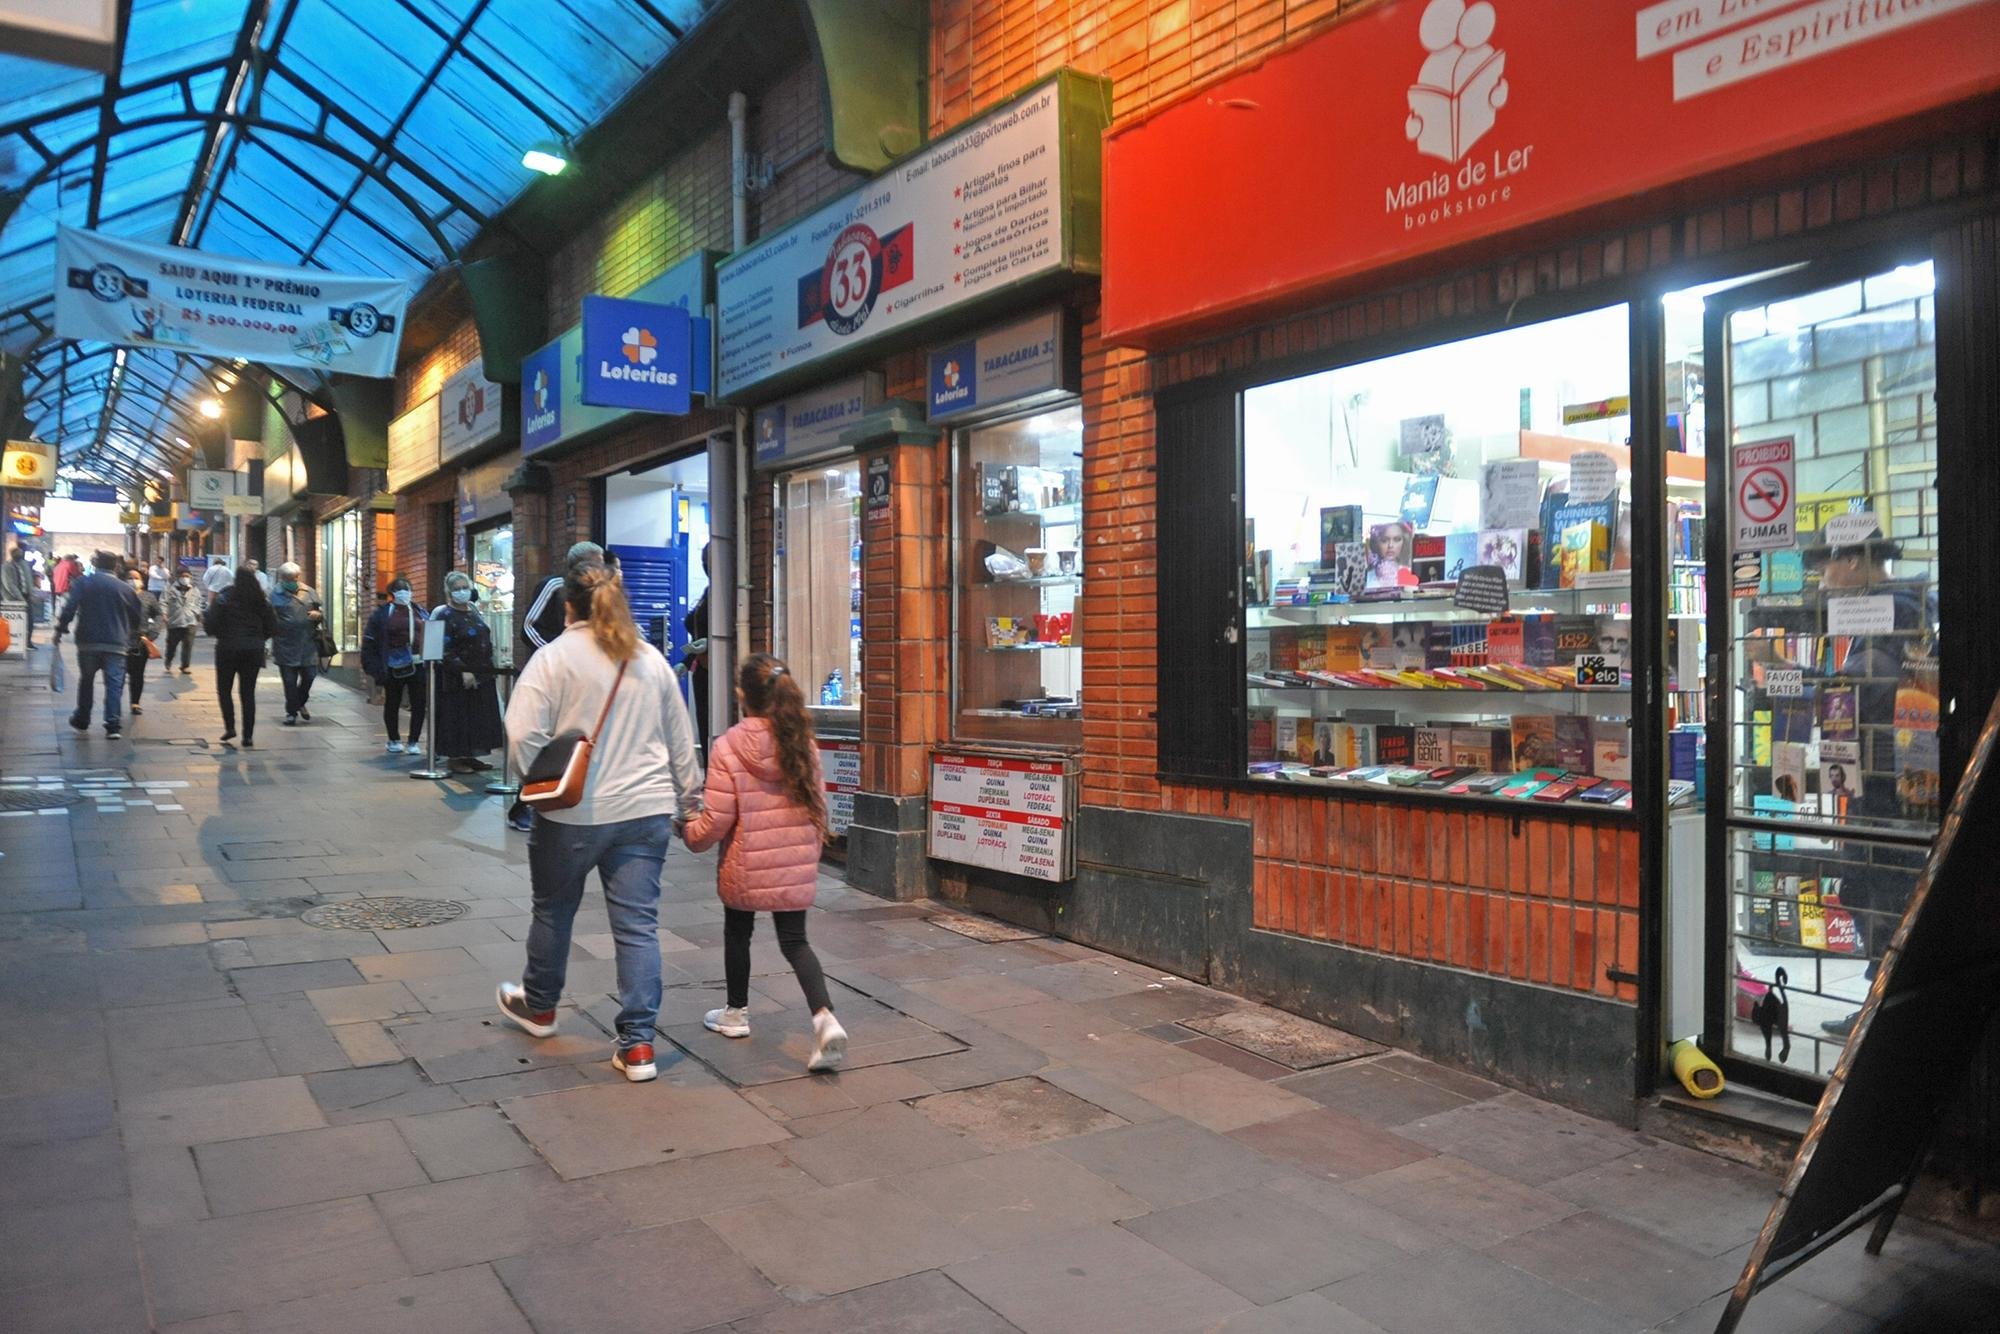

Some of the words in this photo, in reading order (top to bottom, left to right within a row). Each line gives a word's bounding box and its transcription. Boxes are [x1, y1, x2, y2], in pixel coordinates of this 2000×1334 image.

[1656, 7, 1700, 37] em
[1706, 54, 1722, 76] e
[963, 170, 995, 191] Artigos
[1023, 144, 1046, 164] para
[963, 174, 1009, 201] Presentes
[1385, 171, 1450, 214] Mania
[1457, 158, 1487, 191] de
[1494, 144, 1534, 179] Ler
[963, 202, 995, 223] Artigos
[996, 192, 1017, 210] para
[1019, 177, 1048, 196] Bilhar
[1404, 185, 1512, 231] bookstore
[1010, 207, 1049, 229] Dardos
[97, 273, 120, 293] 33
[158, 262, 197, 279] SAIU
[200, 269, 238, 286] AQUI
[264, 279, 321, 298] PRÊMIO
[834, 250, 867, 310] 33
[175, 286, 238, 306] LOTERIA
[242, 296, 304, 316] FEDERAL
[893, 283, 945, 309] Cigarrilhas
[182, 307, 202, 321] R$
[207, 313, 297, 334] 500.000,00
[353, 311, 374, 330] 33
[984, 344, 1039, 372] TABACARIA
[600, 361, 678, 386] Loterias
[1737, 442, 1789, 465] PROIBIDO
[1554, 505, 1608, 520] GUINNESS
[1740, 523, 1788, 540] FUMAR
[1767, 671, 1801, 681] FAVOR
[1769, 684, 1801, 694] BATER
[1417, 731, 1438, 746] ESSA
[1417, 747, 1443, 762] GENTE
[944, 773, 961, 782] QUINA
[986, 778, 1005, 787] QUINA
[1029, 782, 1050, 791] QUINA
[1024, 773, 1057, 783] MEGA-SENA
[1027, 801, 1052, 812] FEDERAL
[943, 822, 960, 831] QUINA
[983, 828, 1002, 838] QUINA
[1027, 836, 1048, 845] QUINA
[1022, 826, 1055, 837] MEGA-SENA
[1019, 854, 1038, 865] DUPLA
[1039, 857, 1055, 868] SENA
[1021, 844, 1054, 856] TIMEMANIA
[1024, 866, 1049, 877] FEDERAL
